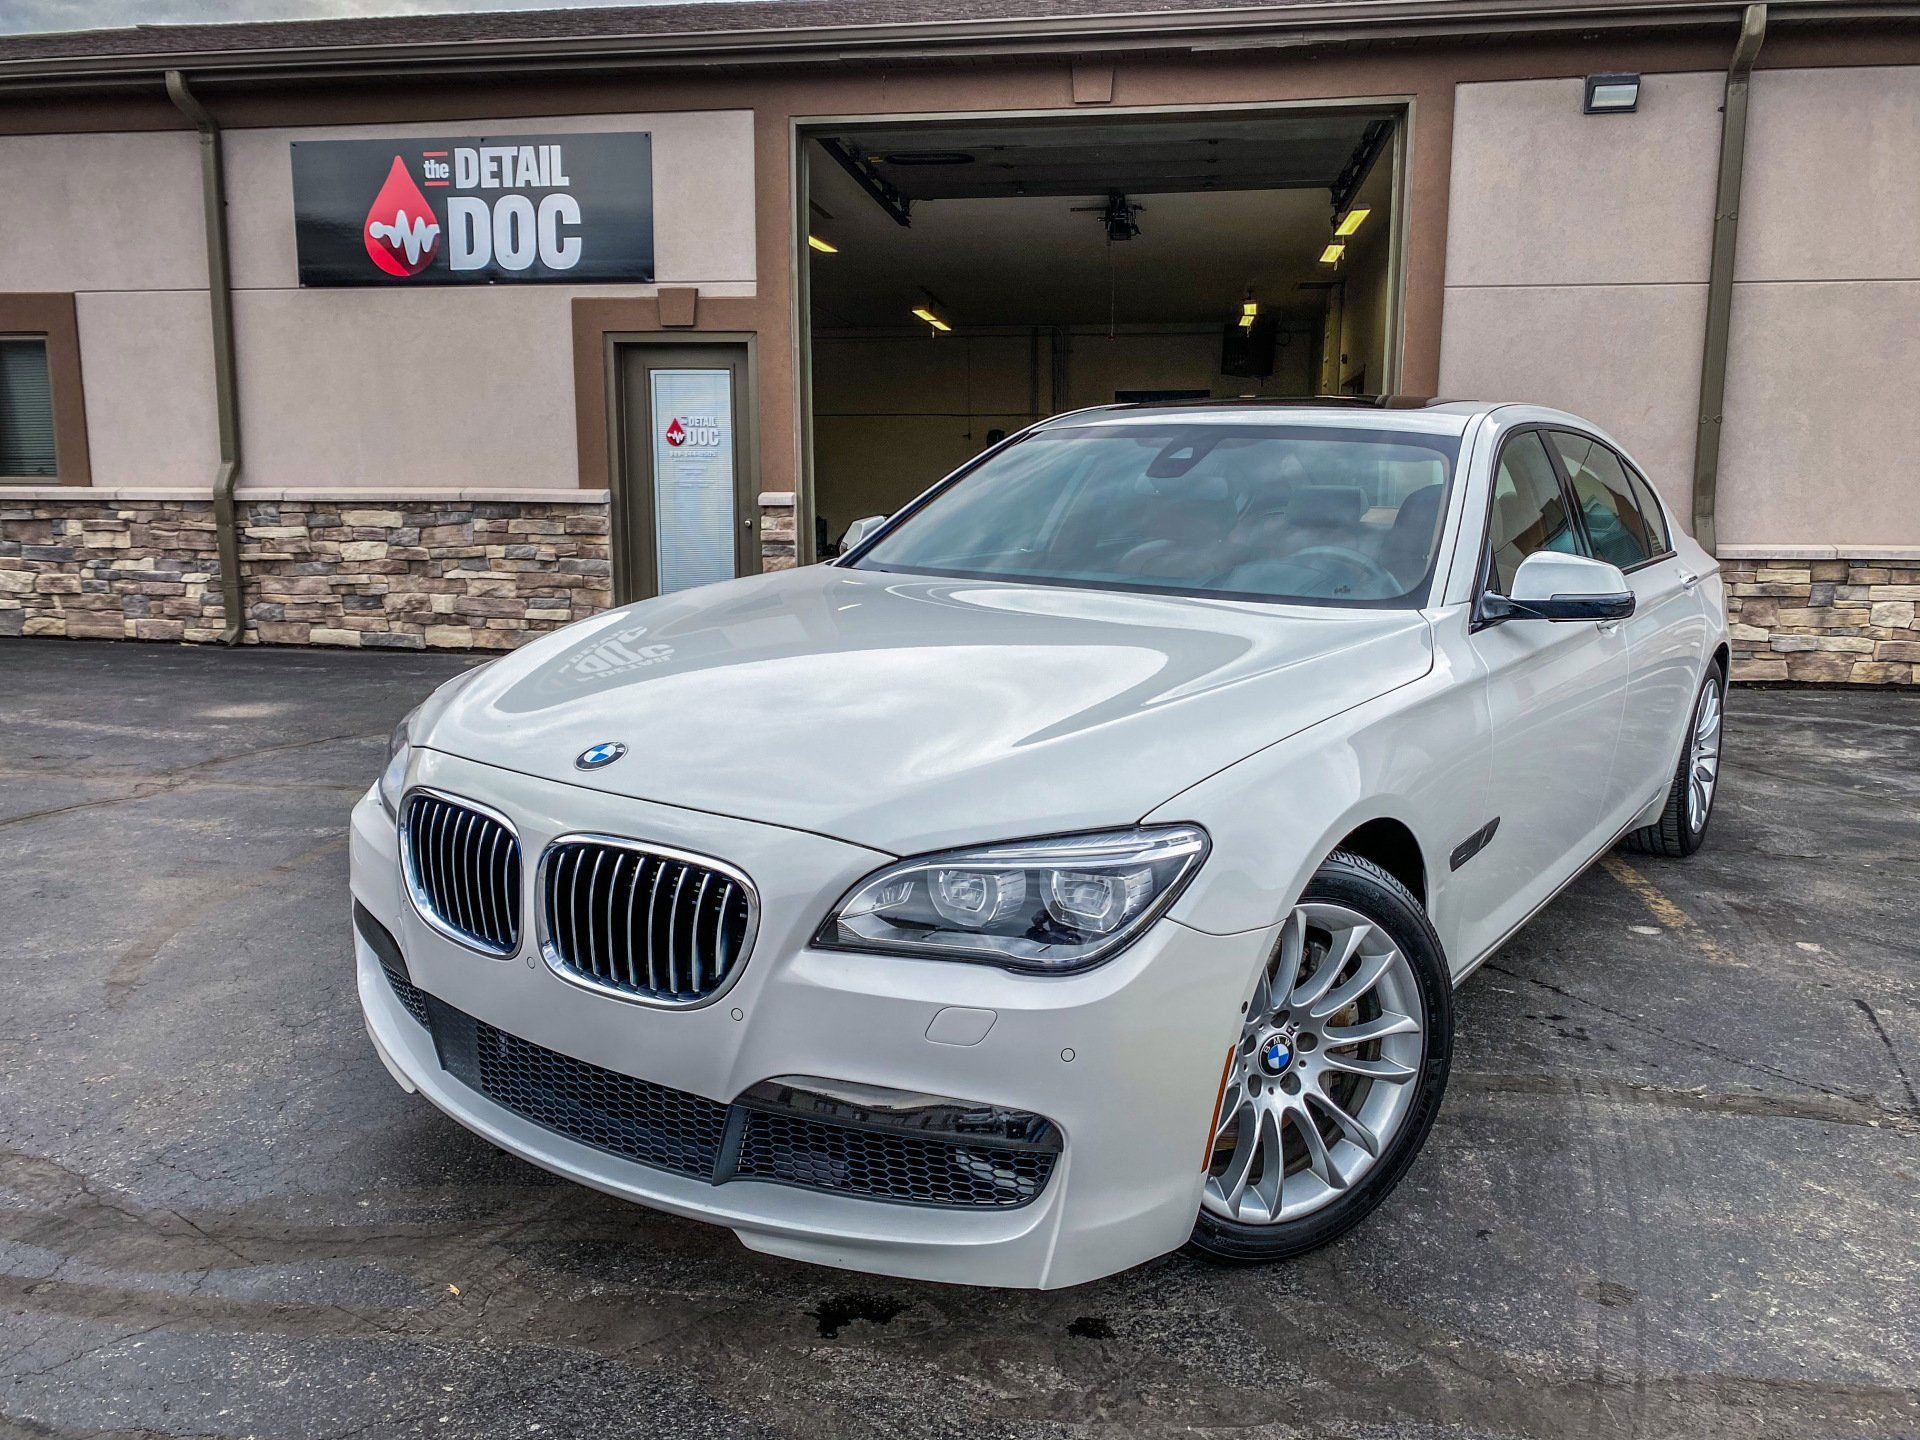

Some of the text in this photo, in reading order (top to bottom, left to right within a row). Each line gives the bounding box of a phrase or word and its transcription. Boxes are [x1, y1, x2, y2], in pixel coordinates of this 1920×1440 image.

[423, 145, 569, 189] the DETAIL
[447, 193, 582, 271] DOC
[688, 416, 716, 427] DETAIL
[687, 428, 719, 446] DOC
[1263, 1035, 1291, 1053] BMW
